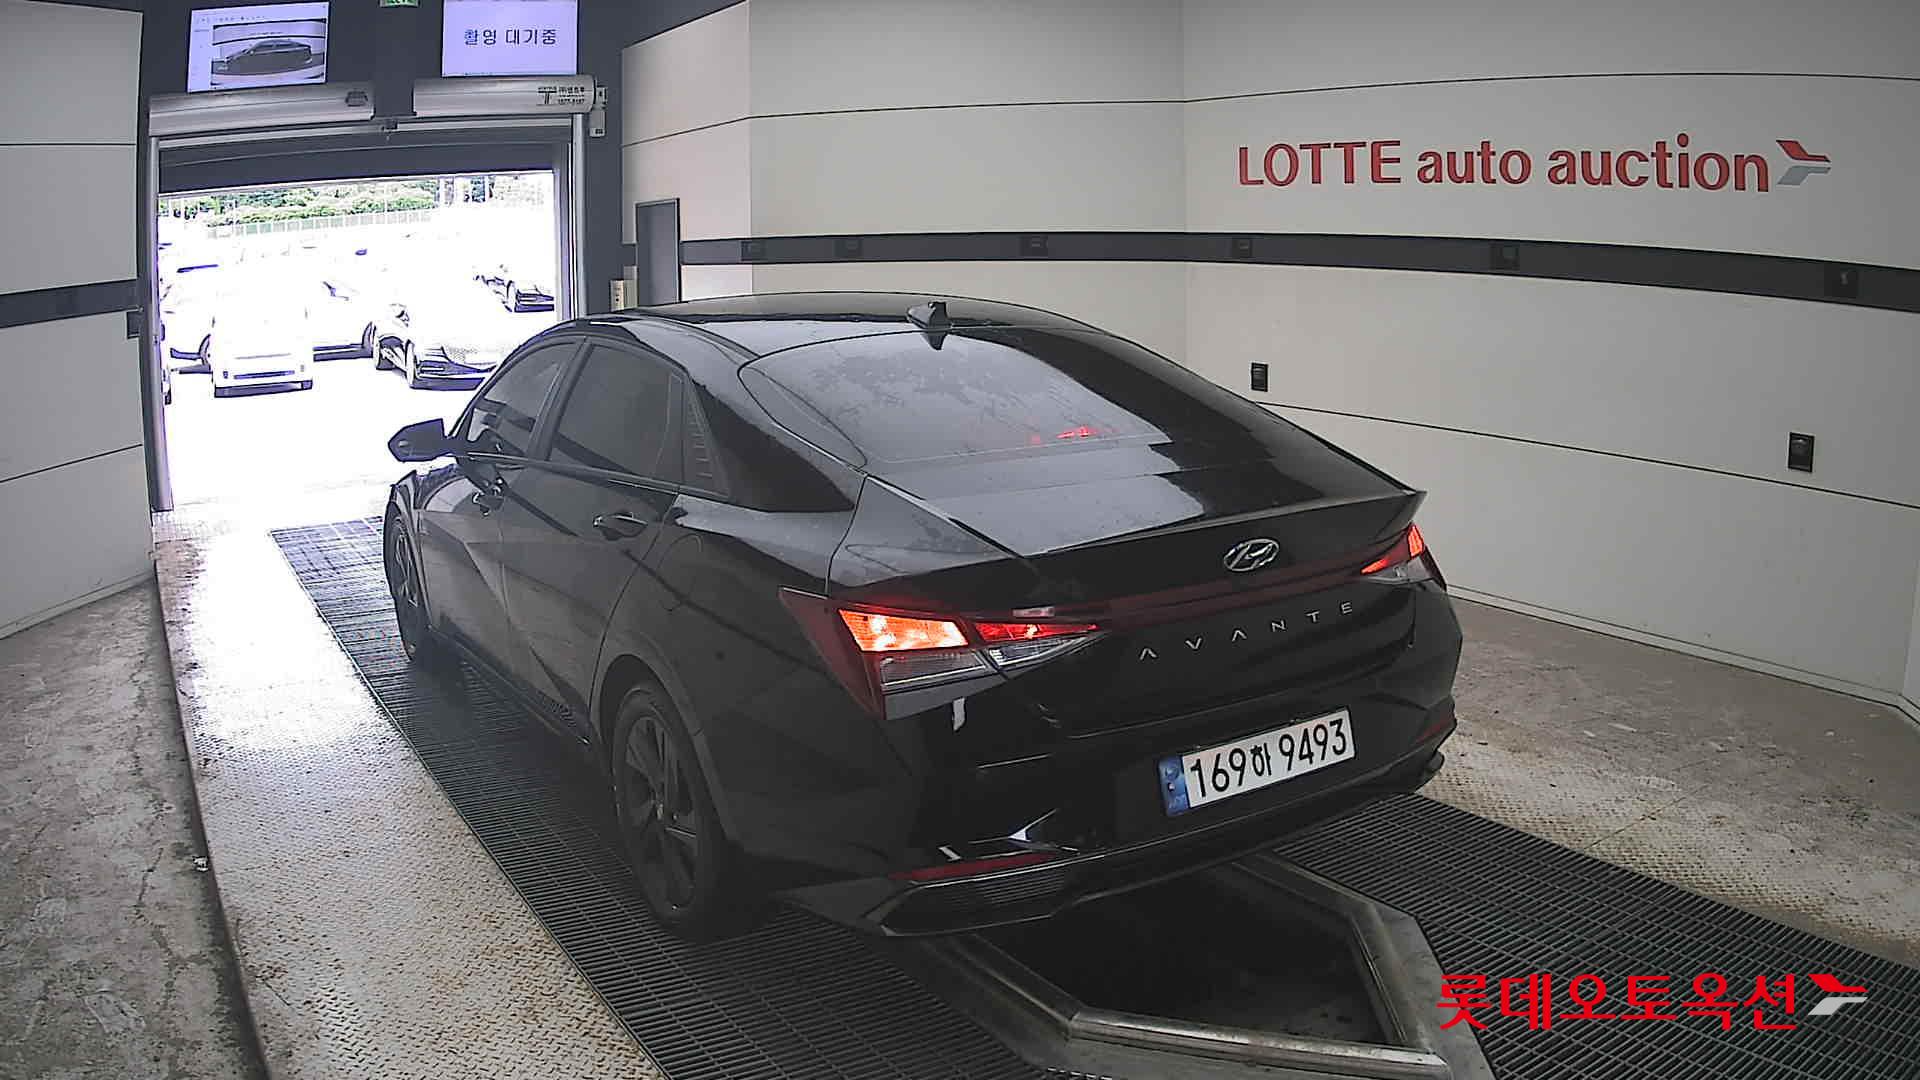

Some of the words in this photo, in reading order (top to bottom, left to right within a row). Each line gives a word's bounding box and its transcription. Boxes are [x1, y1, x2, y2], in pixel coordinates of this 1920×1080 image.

[464, 29, 497, 46] 촬영
[505, 29, 557, 46] 대기중
[1239, 140, 1401, 187] LOTTE
[1417, 139, 1532, 186] auto
[1548, 133, 1769, 193] auction
[1139, 602, 1354, 661] AVANTE
[1279, 718, 1347, 772] 9493
